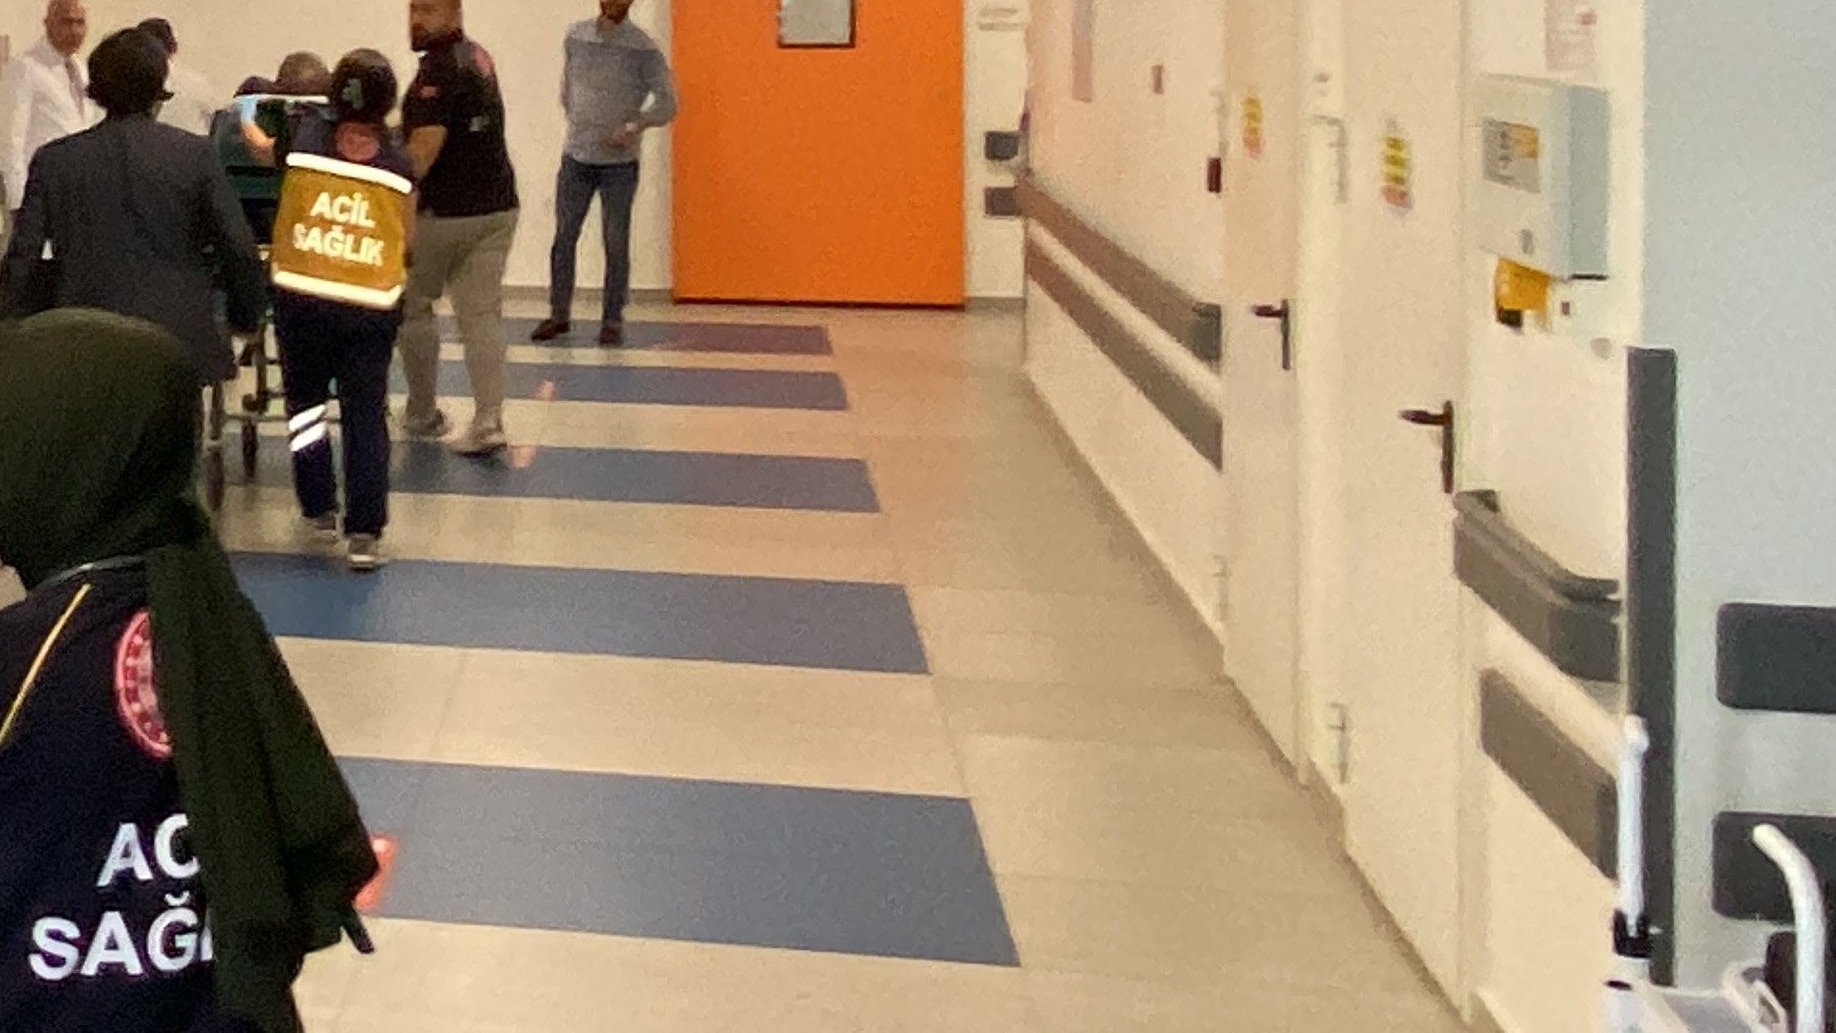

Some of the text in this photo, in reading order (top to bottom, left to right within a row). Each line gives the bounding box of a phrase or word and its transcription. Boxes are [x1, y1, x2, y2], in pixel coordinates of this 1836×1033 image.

[310, 191, 376, 228] ACİL
[292, 223, 385, 267] SAĞLIK
[97, 813, 201, 888] AC
[29, 891, 213, 981] SAĞ
